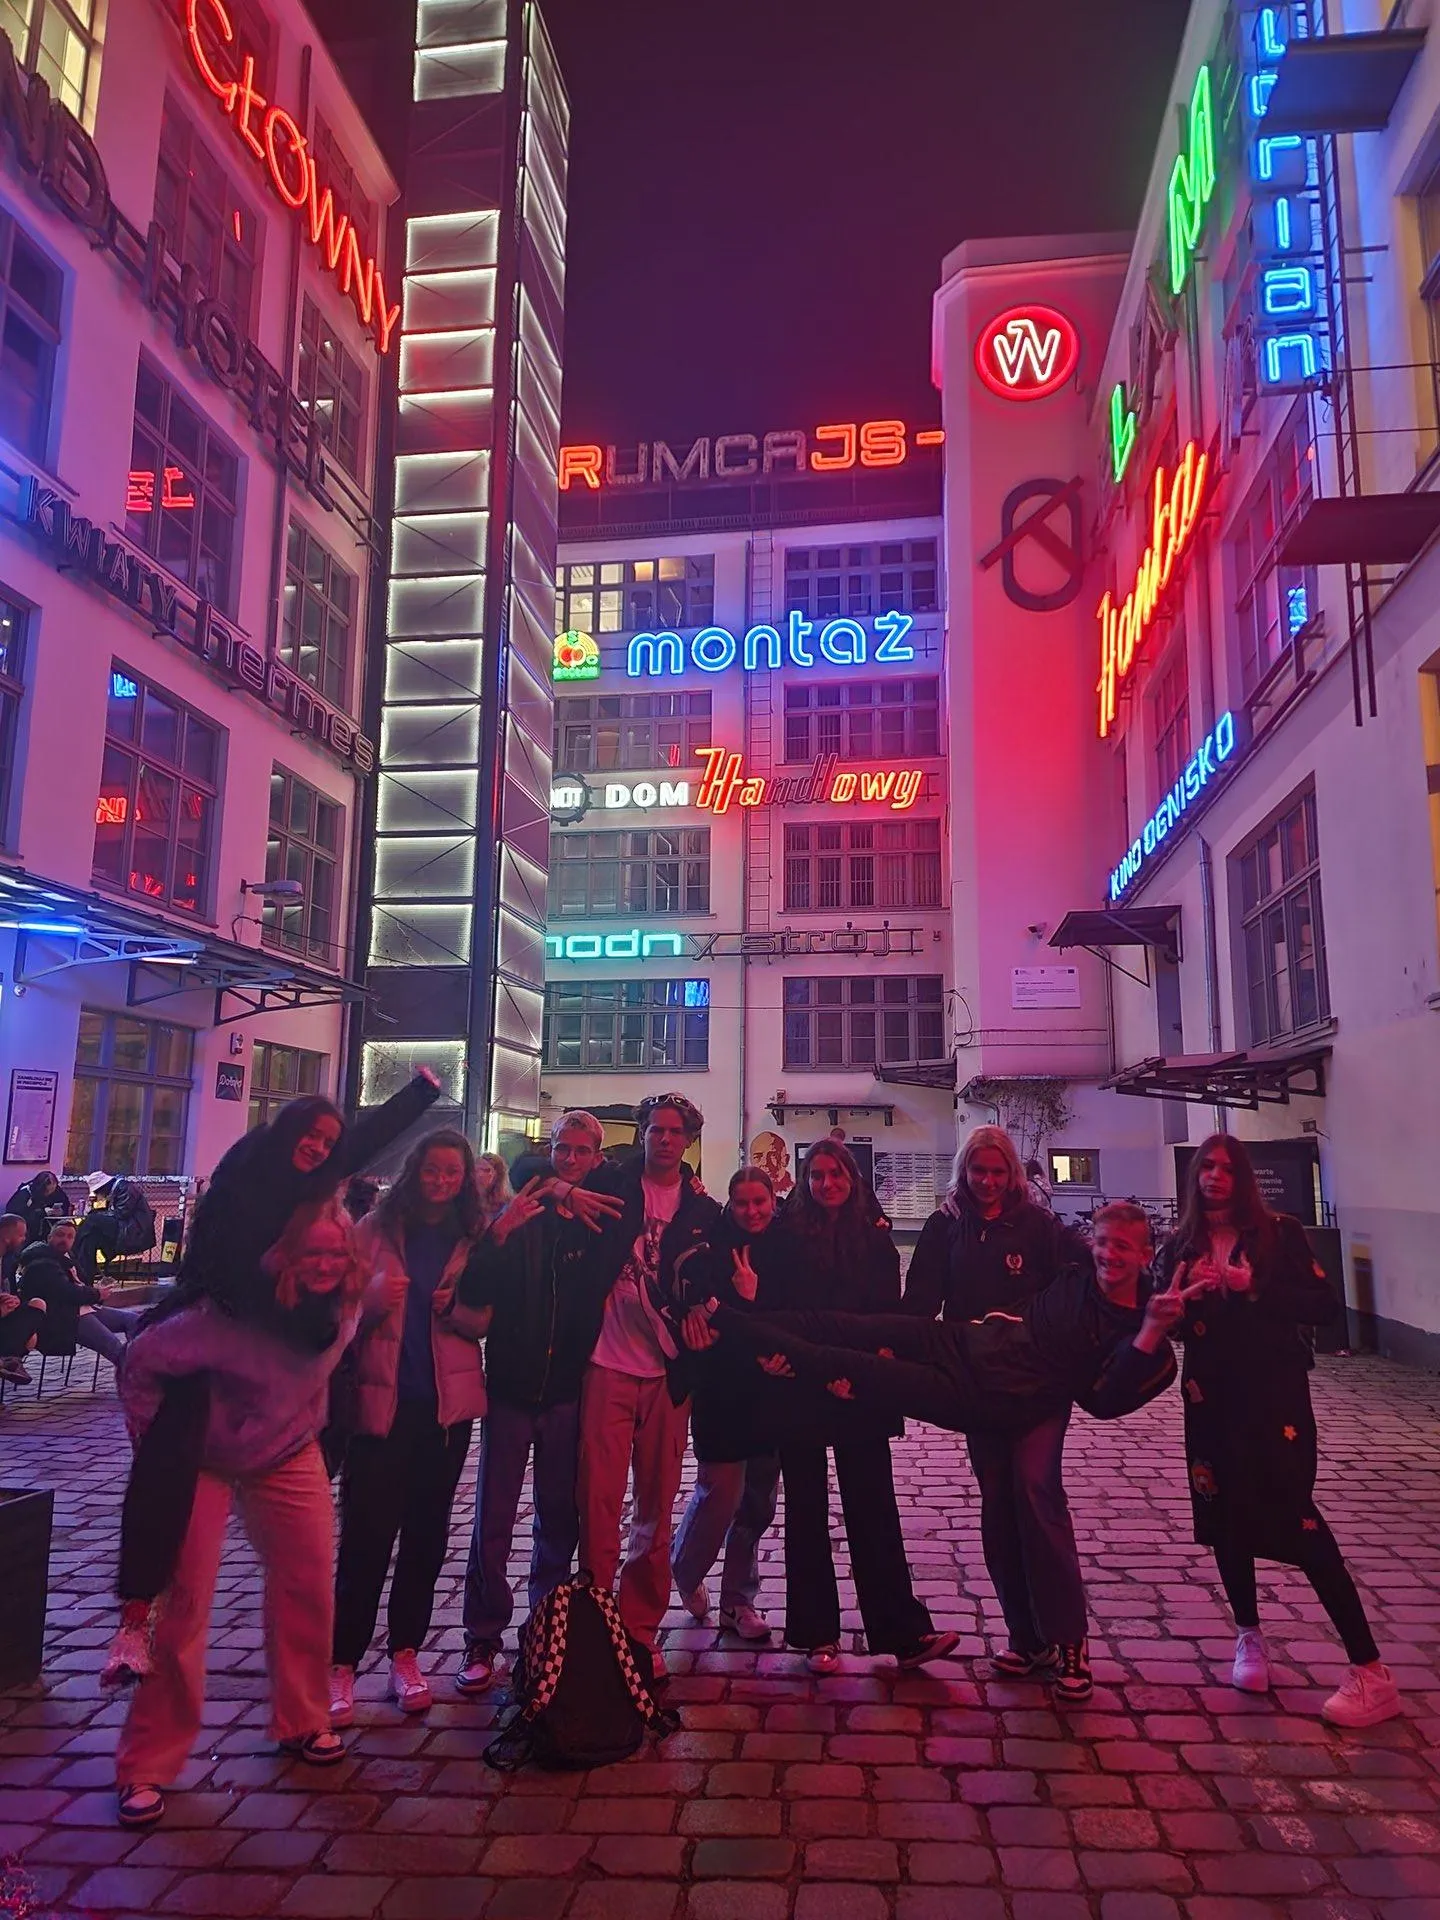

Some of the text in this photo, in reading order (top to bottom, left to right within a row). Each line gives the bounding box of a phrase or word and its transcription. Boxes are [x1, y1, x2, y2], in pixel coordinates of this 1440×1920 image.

[146, 219, 334, 512] HOTEL
[26, 474, 375, 774] KWIATY hermes
[627, 609, 915, 677] montaż
[604, 746, 924, 815] DOM Handlowy
[1109, 711, 1235, 902] KINO OGNISKO
